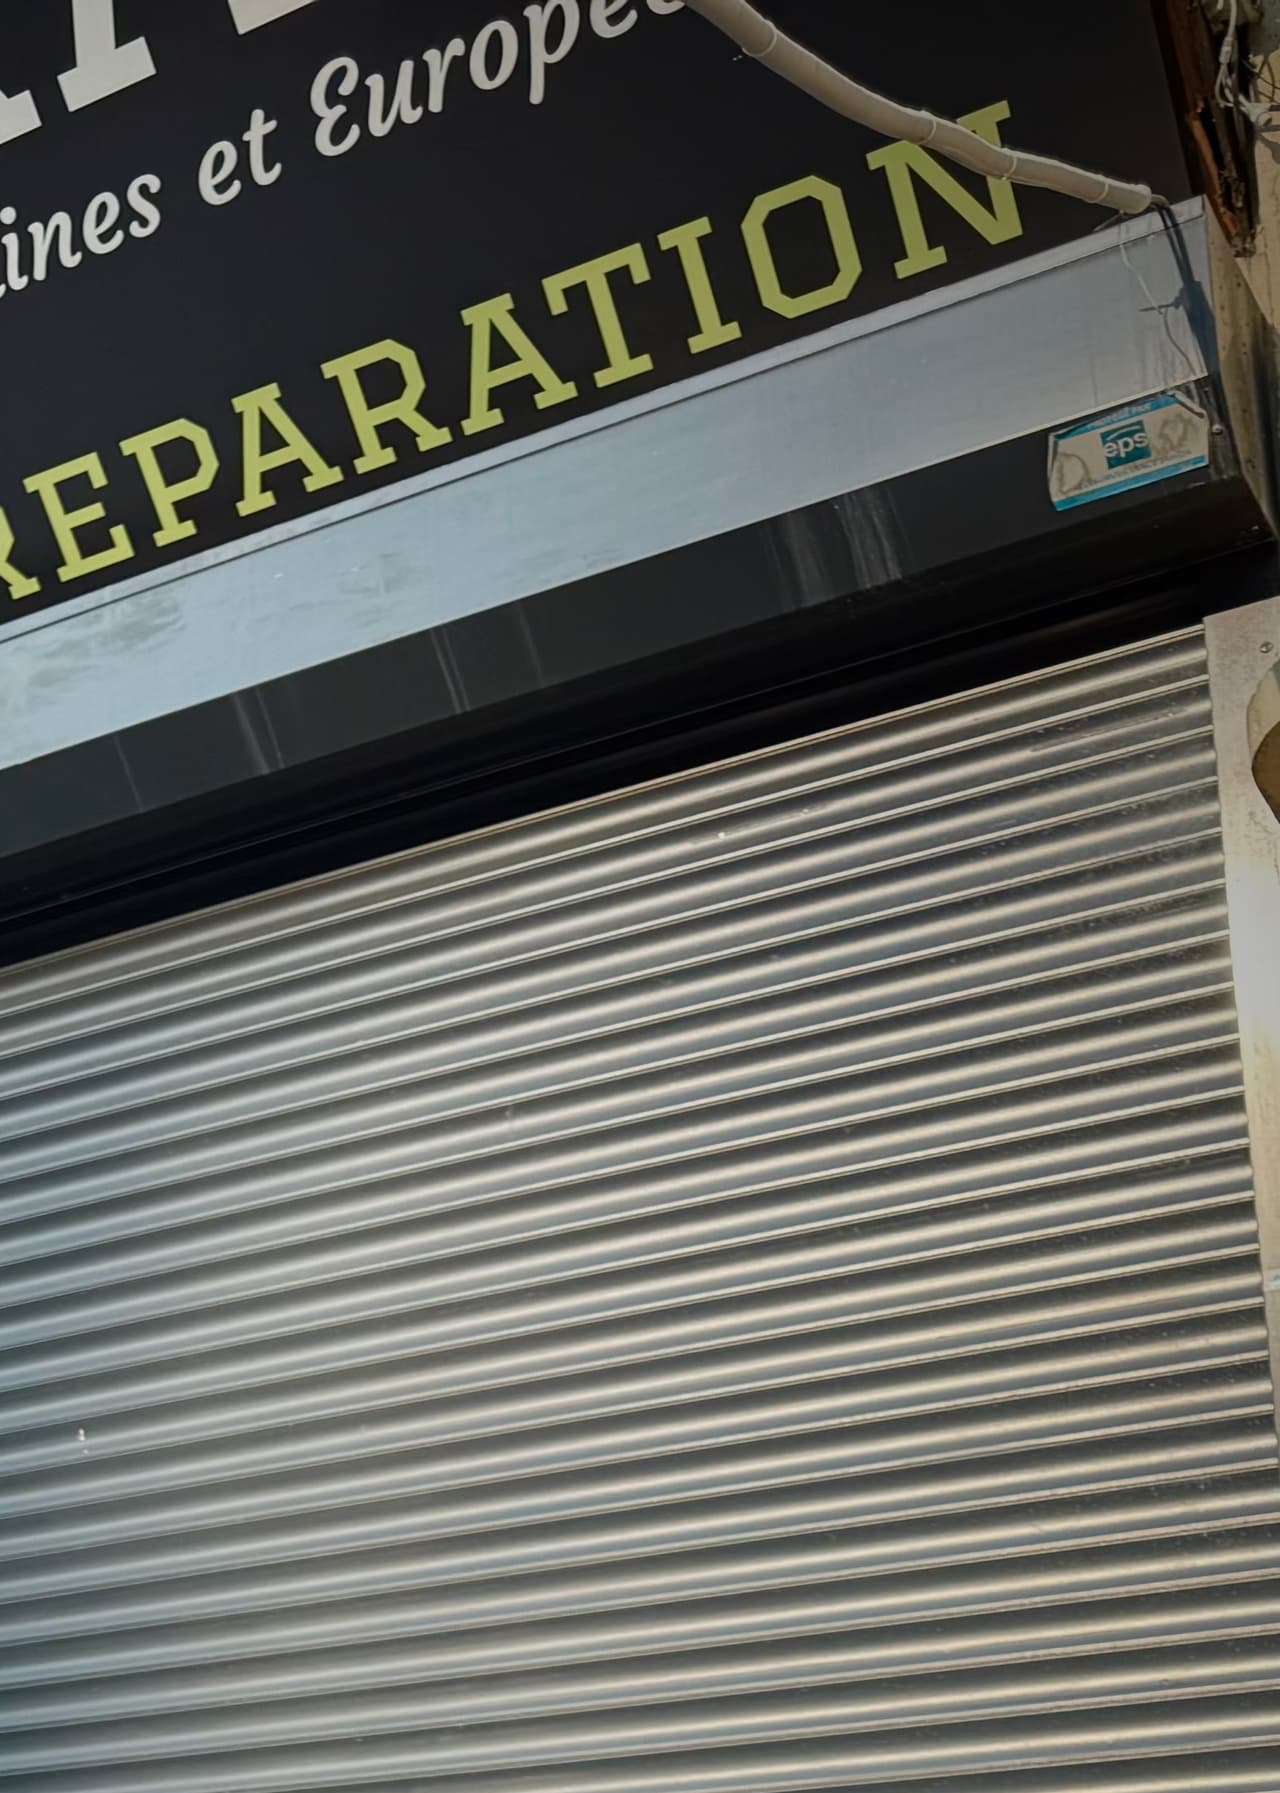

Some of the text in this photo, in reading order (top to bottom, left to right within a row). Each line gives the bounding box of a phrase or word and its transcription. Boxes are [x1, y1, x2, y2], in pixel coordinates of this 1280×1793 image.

[198, 108, 283, 206] et
[310, 0, 687, 157] Europ
[1104, 432, 1148, 458] eps
